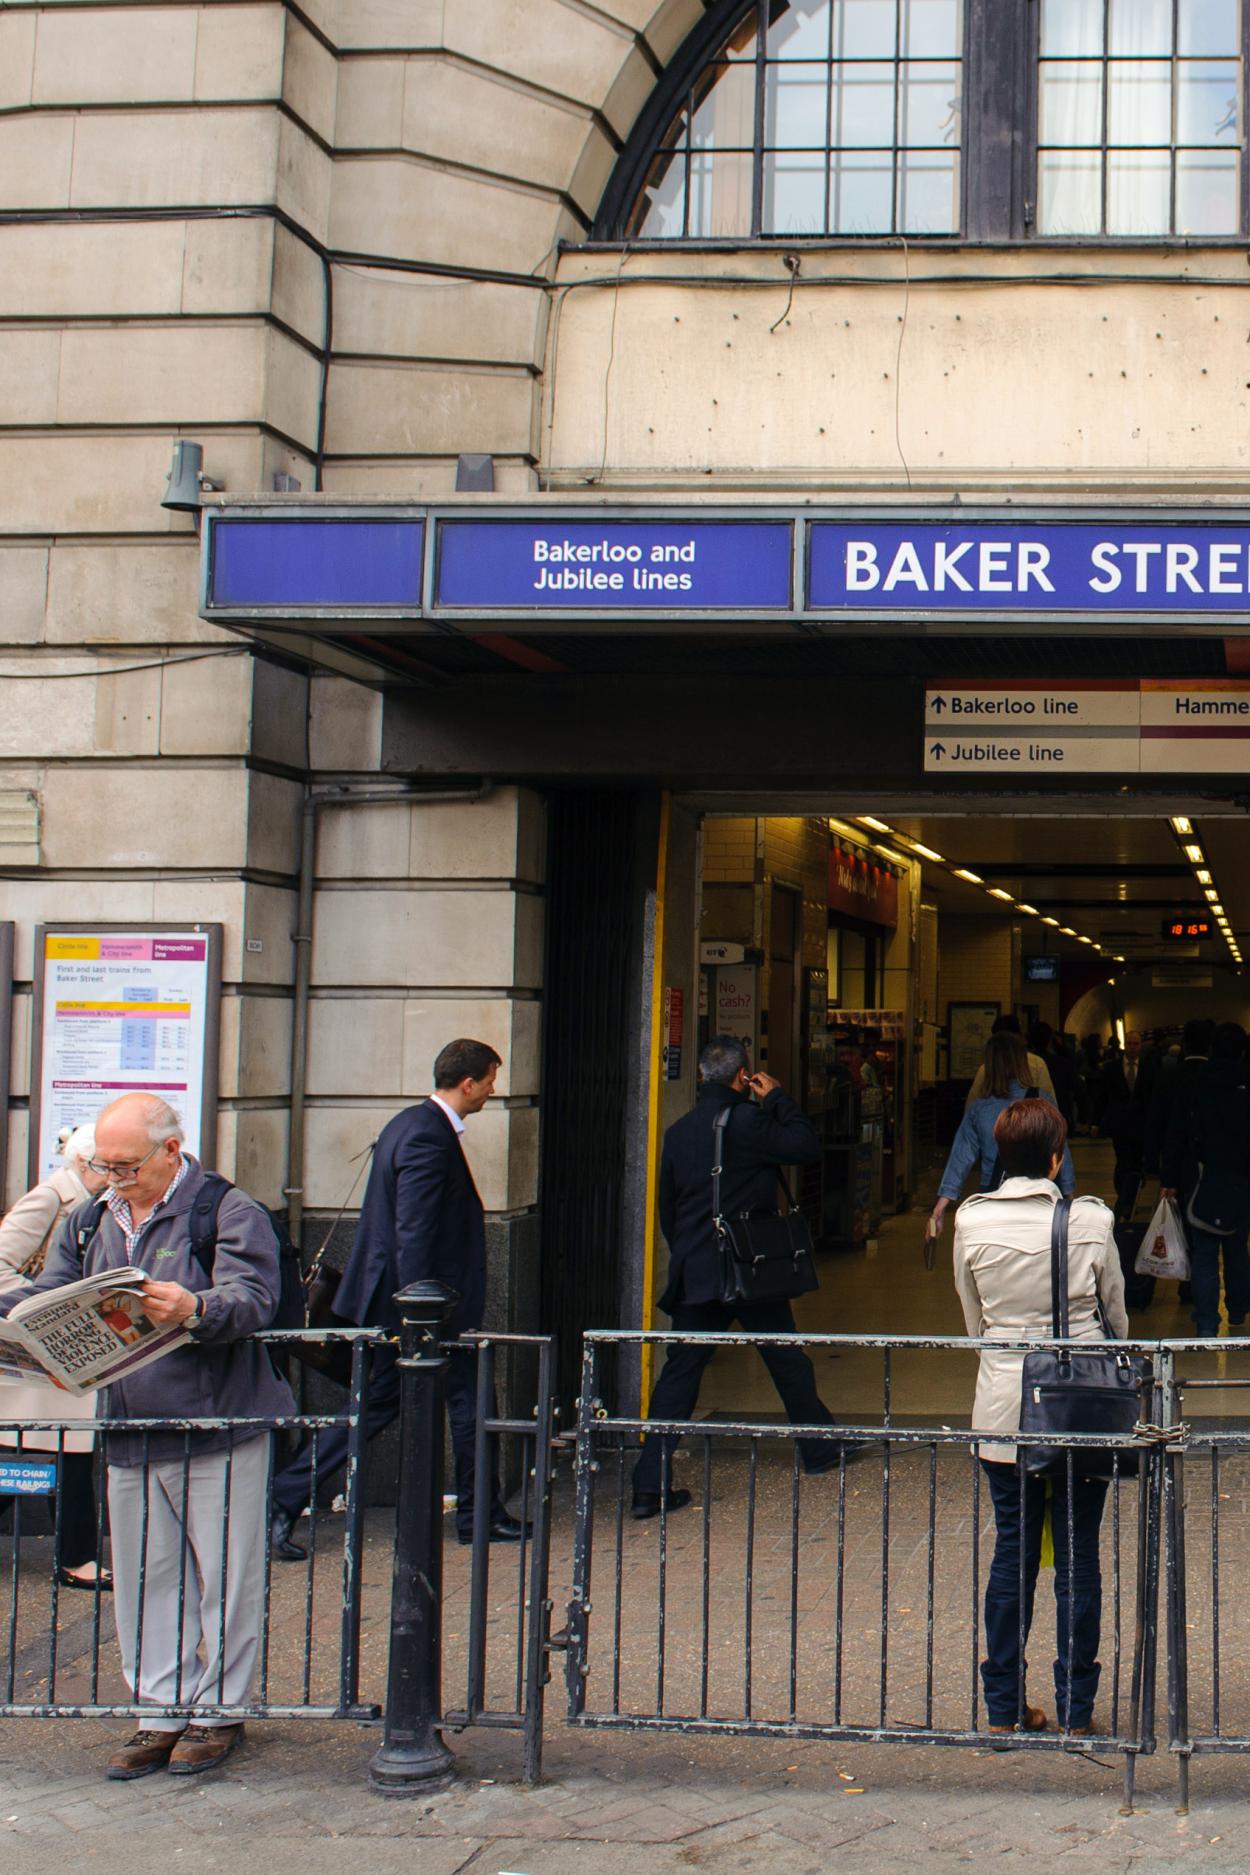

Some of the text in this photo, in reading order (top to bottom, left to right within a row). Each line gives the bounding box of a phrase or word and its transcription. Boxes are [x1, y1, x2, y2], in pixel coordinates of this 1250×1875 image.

[534, 540, 696, 563] Bakerloo and
[845, 540, 1056, 593] BAKER
[534, 568, 693, 590] Jubilee lines
[951, 697, 1079, 715] Bakerloo line
[951, 744, 1065, 762] Jubilee line
[1171, 924, 1183, 936] 18
[1187, 924, 1199, 936] 16
[154, 944, 195, 952] Metropolitan
[56, 965, 74, 973] First
[108, 966, 131, 974] trains
[132, 966, 152, 974] from
[56, 975, 104, 983] Baker Street
[720, 982, 736, 994] No
[719, 994, 752, 1008] cash?
[23, 1302, 72, 1329] Evening
[27, 1302, 80, 1332] Standard
[39, 1311, 97, 1346] THE FULL
[46, 1322, 97, 1355] HORROR
[52, 1328, 102, 1360] OF GANG
[58, 1331, 114, 1365] VIOLENCE
[63, 1341, 118, 1374] EXPOSED
[9, 1469, 20, 1477] TO
[16, 1480, 51, 1489] RAILINGS
